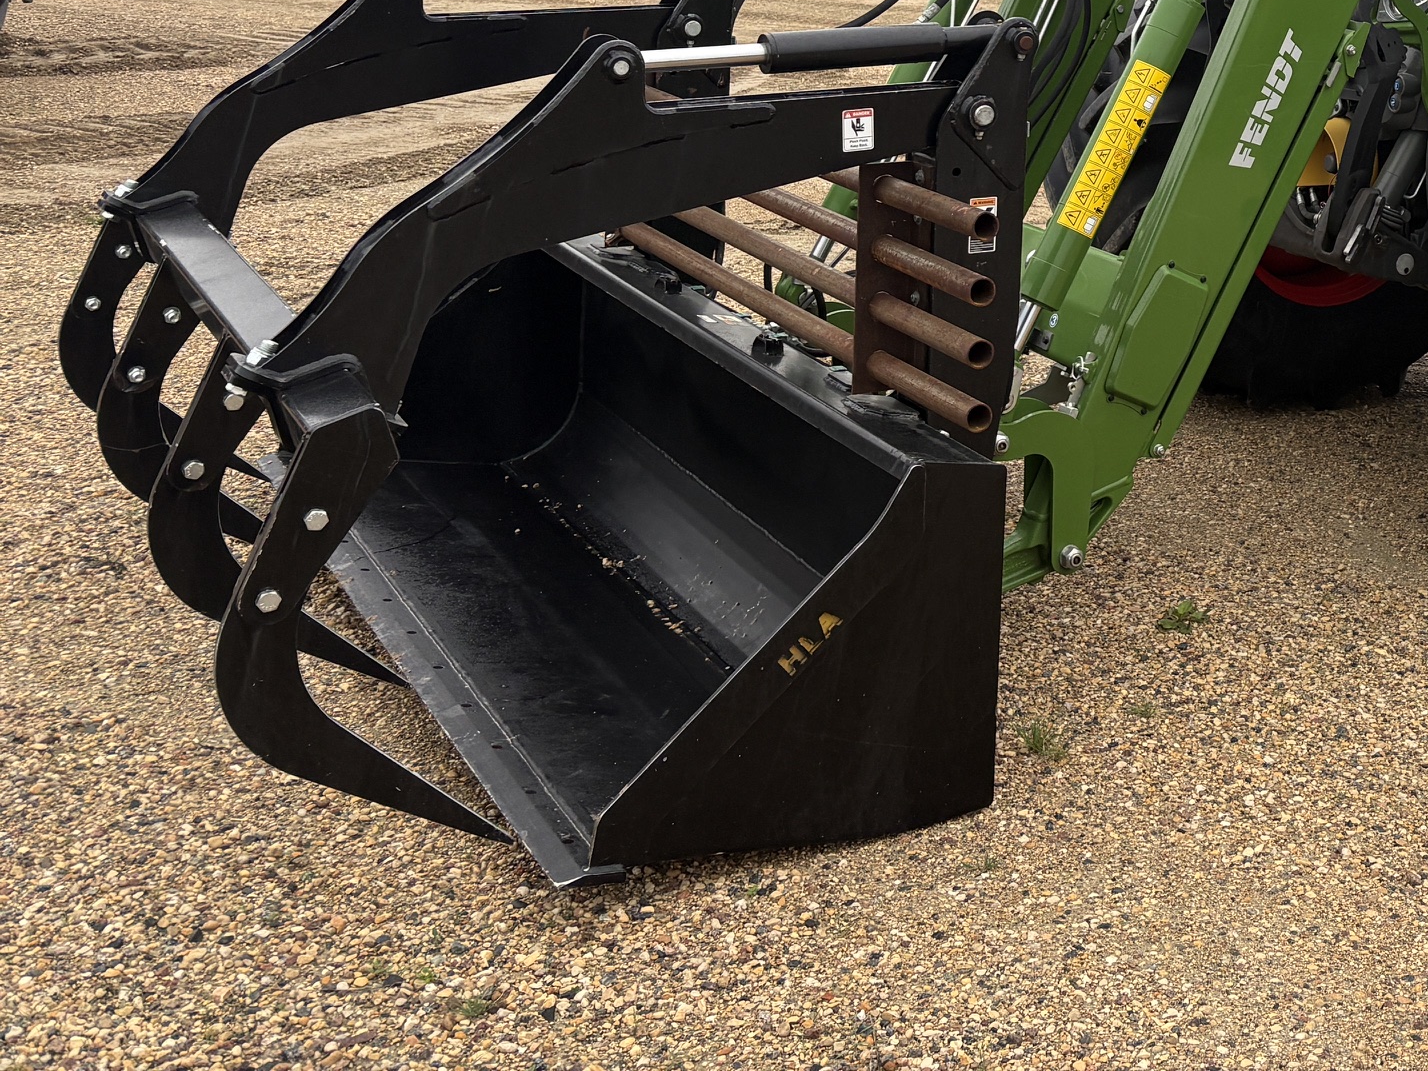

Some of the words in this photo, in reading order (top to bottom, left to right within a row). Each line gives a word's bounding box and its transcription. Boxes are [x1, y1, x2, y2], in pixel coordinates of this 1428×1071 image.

[1229, 28, 1302, 168] FENDT
[1050, 315, 1057, 326] 3
[778, 612, 843, 677] HLA
